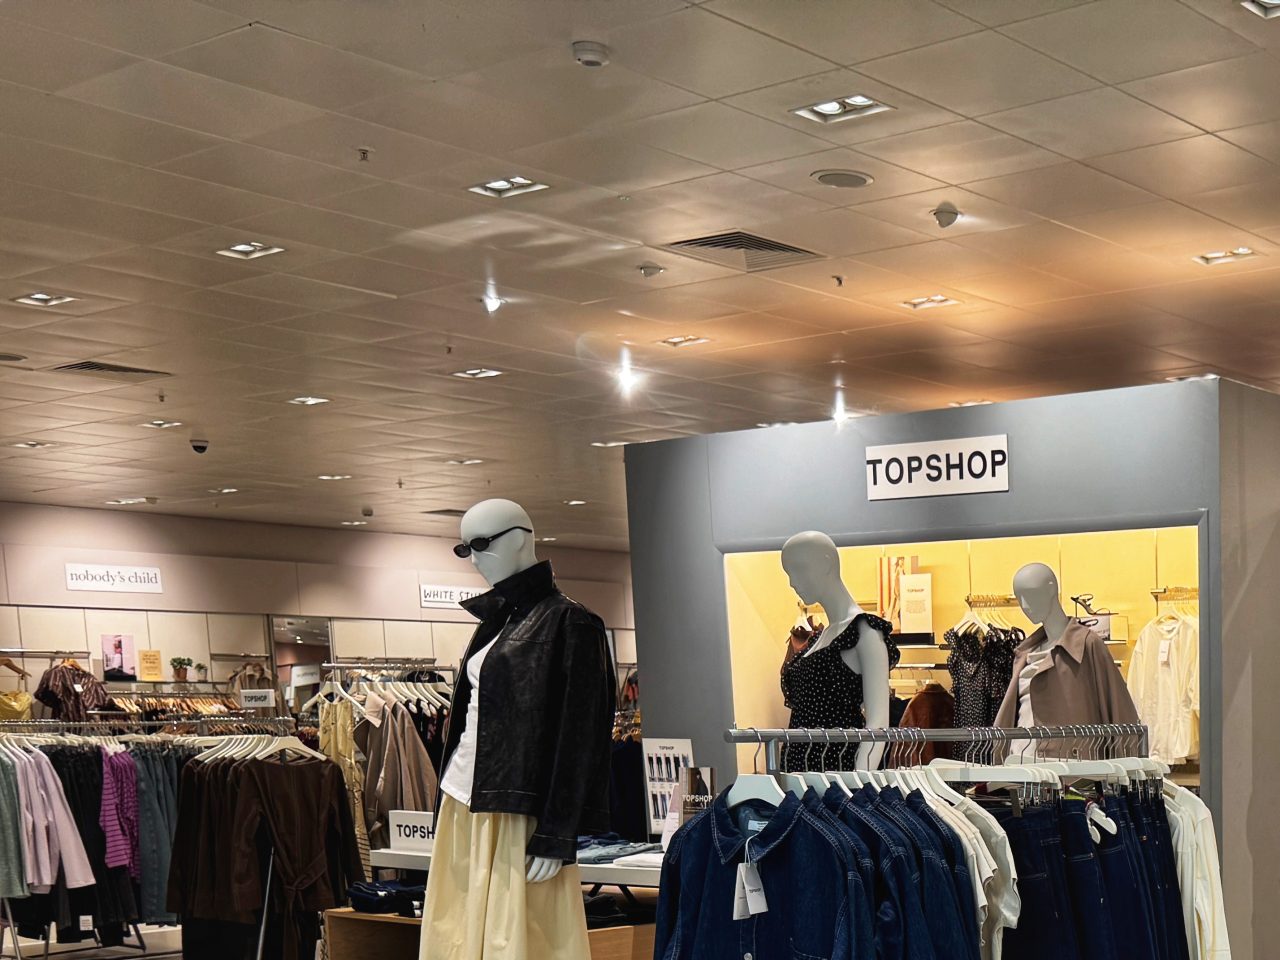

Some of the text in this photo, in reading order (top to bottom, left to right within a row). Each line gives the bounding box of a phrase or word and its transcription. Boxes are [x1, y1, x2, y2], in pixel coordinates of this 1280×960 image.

[866, 449, 1007, 486] TOPSHOP
[70, 569, 158, 586] nobody's child
[423, 589, 454, 600] WHITE
[244, 695, 268, 703] TOPSHOP
[682, 794, 713, 803] TOPSHOP
[396, 824, 435, 840] TOPSH
